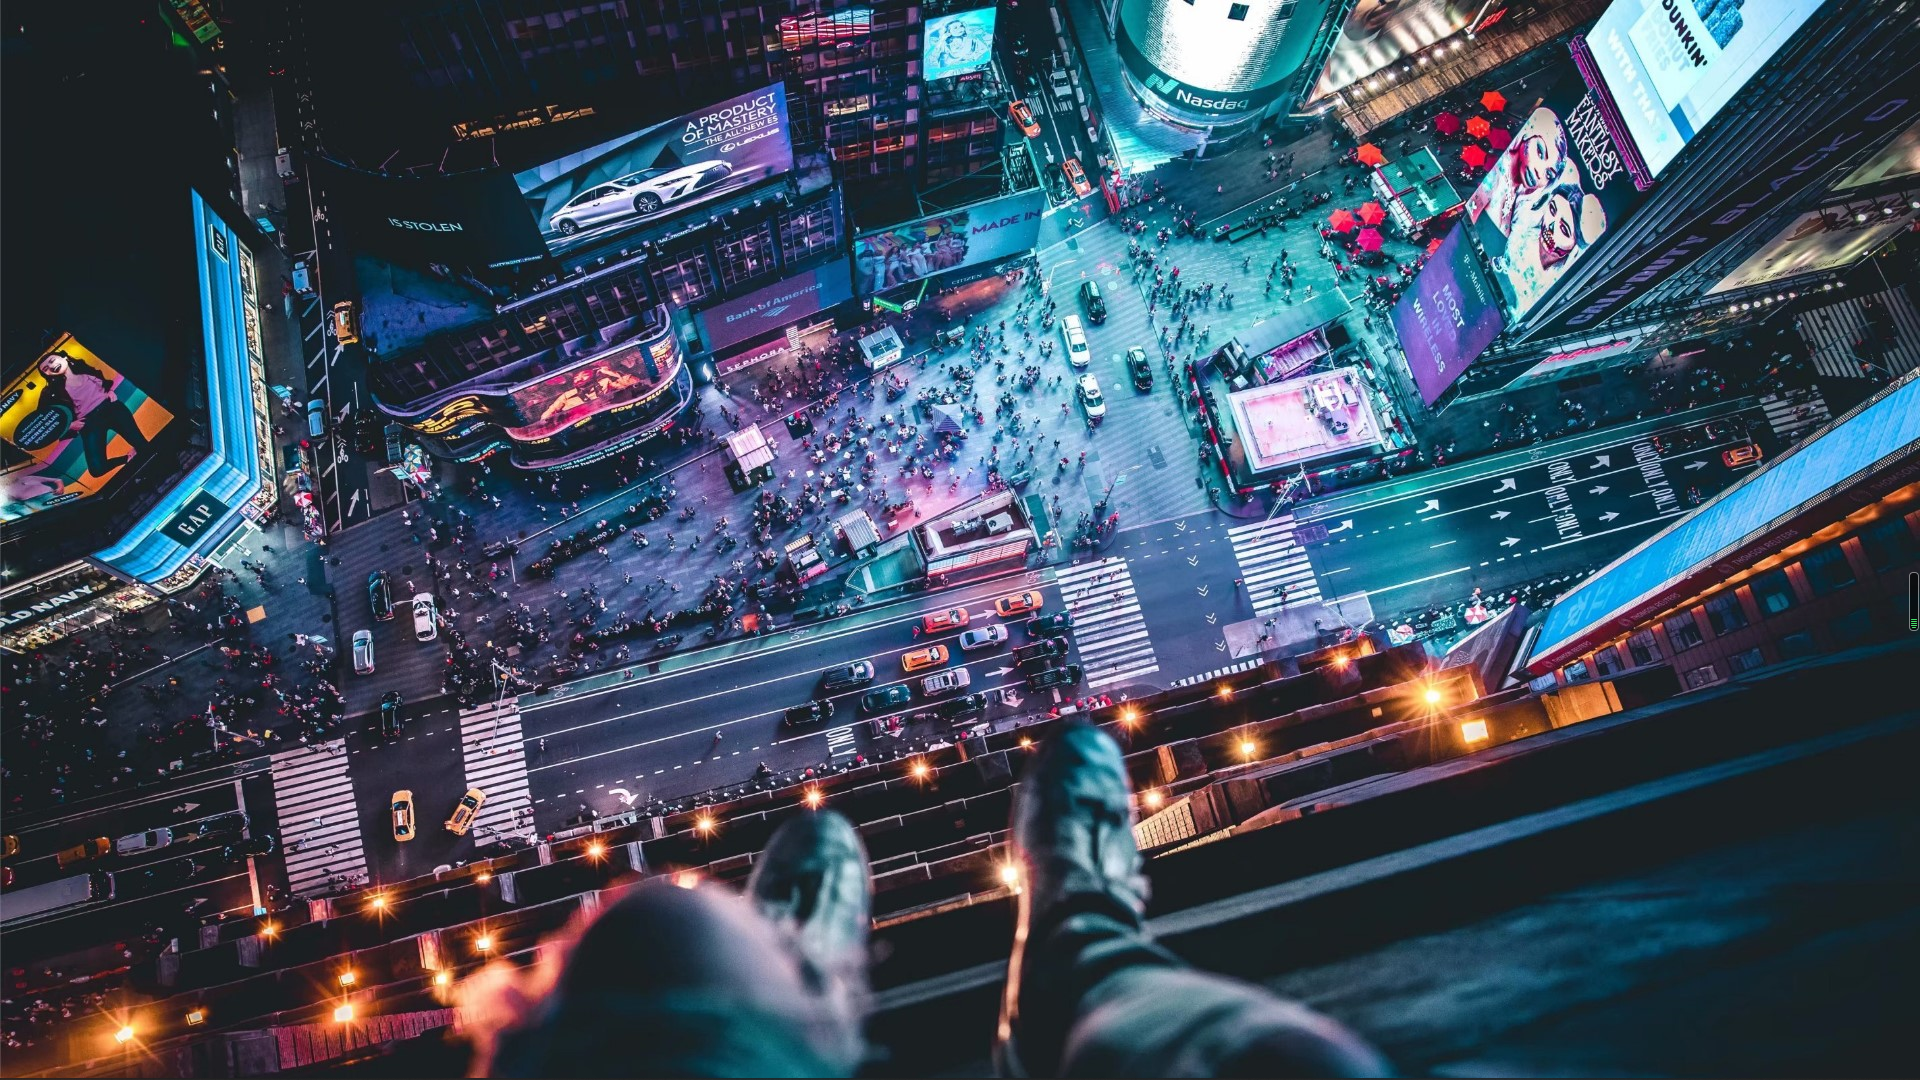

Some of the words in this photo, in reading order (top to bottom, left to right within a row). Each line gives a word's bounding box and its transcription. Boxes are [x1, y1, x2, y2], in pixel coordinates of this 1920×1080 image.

[1661, 0, 1708, 68] DUNKIN'
[1607, 27, 1637, 84] WITH
[685, 121, 698, 133] A
[699, 92, 776, 128] PRODUCT
[1175, 87, 1249, 111] Nasdaq
[682, 128, 705, 143] OF
[707, 103, 777, 136] MASTERY
[704, 135, 723, 146] THE
[725, 120, 765, 139] ALL-NEW
[767, 115, 779, 125] ES
[736, 127, 780, 147] LEXUS
[1576, 93, 1623, 181] FANTASY
[1565, 107, 1609, 190] MAKERS
[387, 217, 403, 228] IS
[402, 220, 464, 232] STOLEN
[972, 213, 1021, 235] MADE
[1024, 208, 1041, 222] IN
[1565, 286, 1636, 325] CALL
[1625, 234, 1708, 283] DUTY
[1710, 131, 1864, 225] BLACK
[951, 273, 984, 285] CITIZEN
[725, 303, 758, 324] Bank
[757, 300, 772, 312] of
[773, 282, 824, 306] America
[1432, 290, 1457, 343] LOVED
[1442, 283, 1466, 328] MOST
[1413, 298, 1446, 374] WIRELESS
[1431, 317, 1442, 337] IN
[727, 346, 787, 373] SEPHORA
[1, 392, 20, 409] NAVY
[611, 403, 634, 414] NOW
[34, 420, 60, 444] POCKETS
[1547, 461, 1577, 484] ONLY
[1639, 461, 1669, 489] ONLY
[1544, 486, 1574, 517] ONLY
[1651, 487, 1681, 515] ONLY
[177, 503, 213, 537] GAP
[1731, 543, 1768, 567] THOMSON
[1765, 529, 1799, 553] REUTERS
[31, 584, 94, 613] NAVY
[825, 727, 858, 758] ONLY
